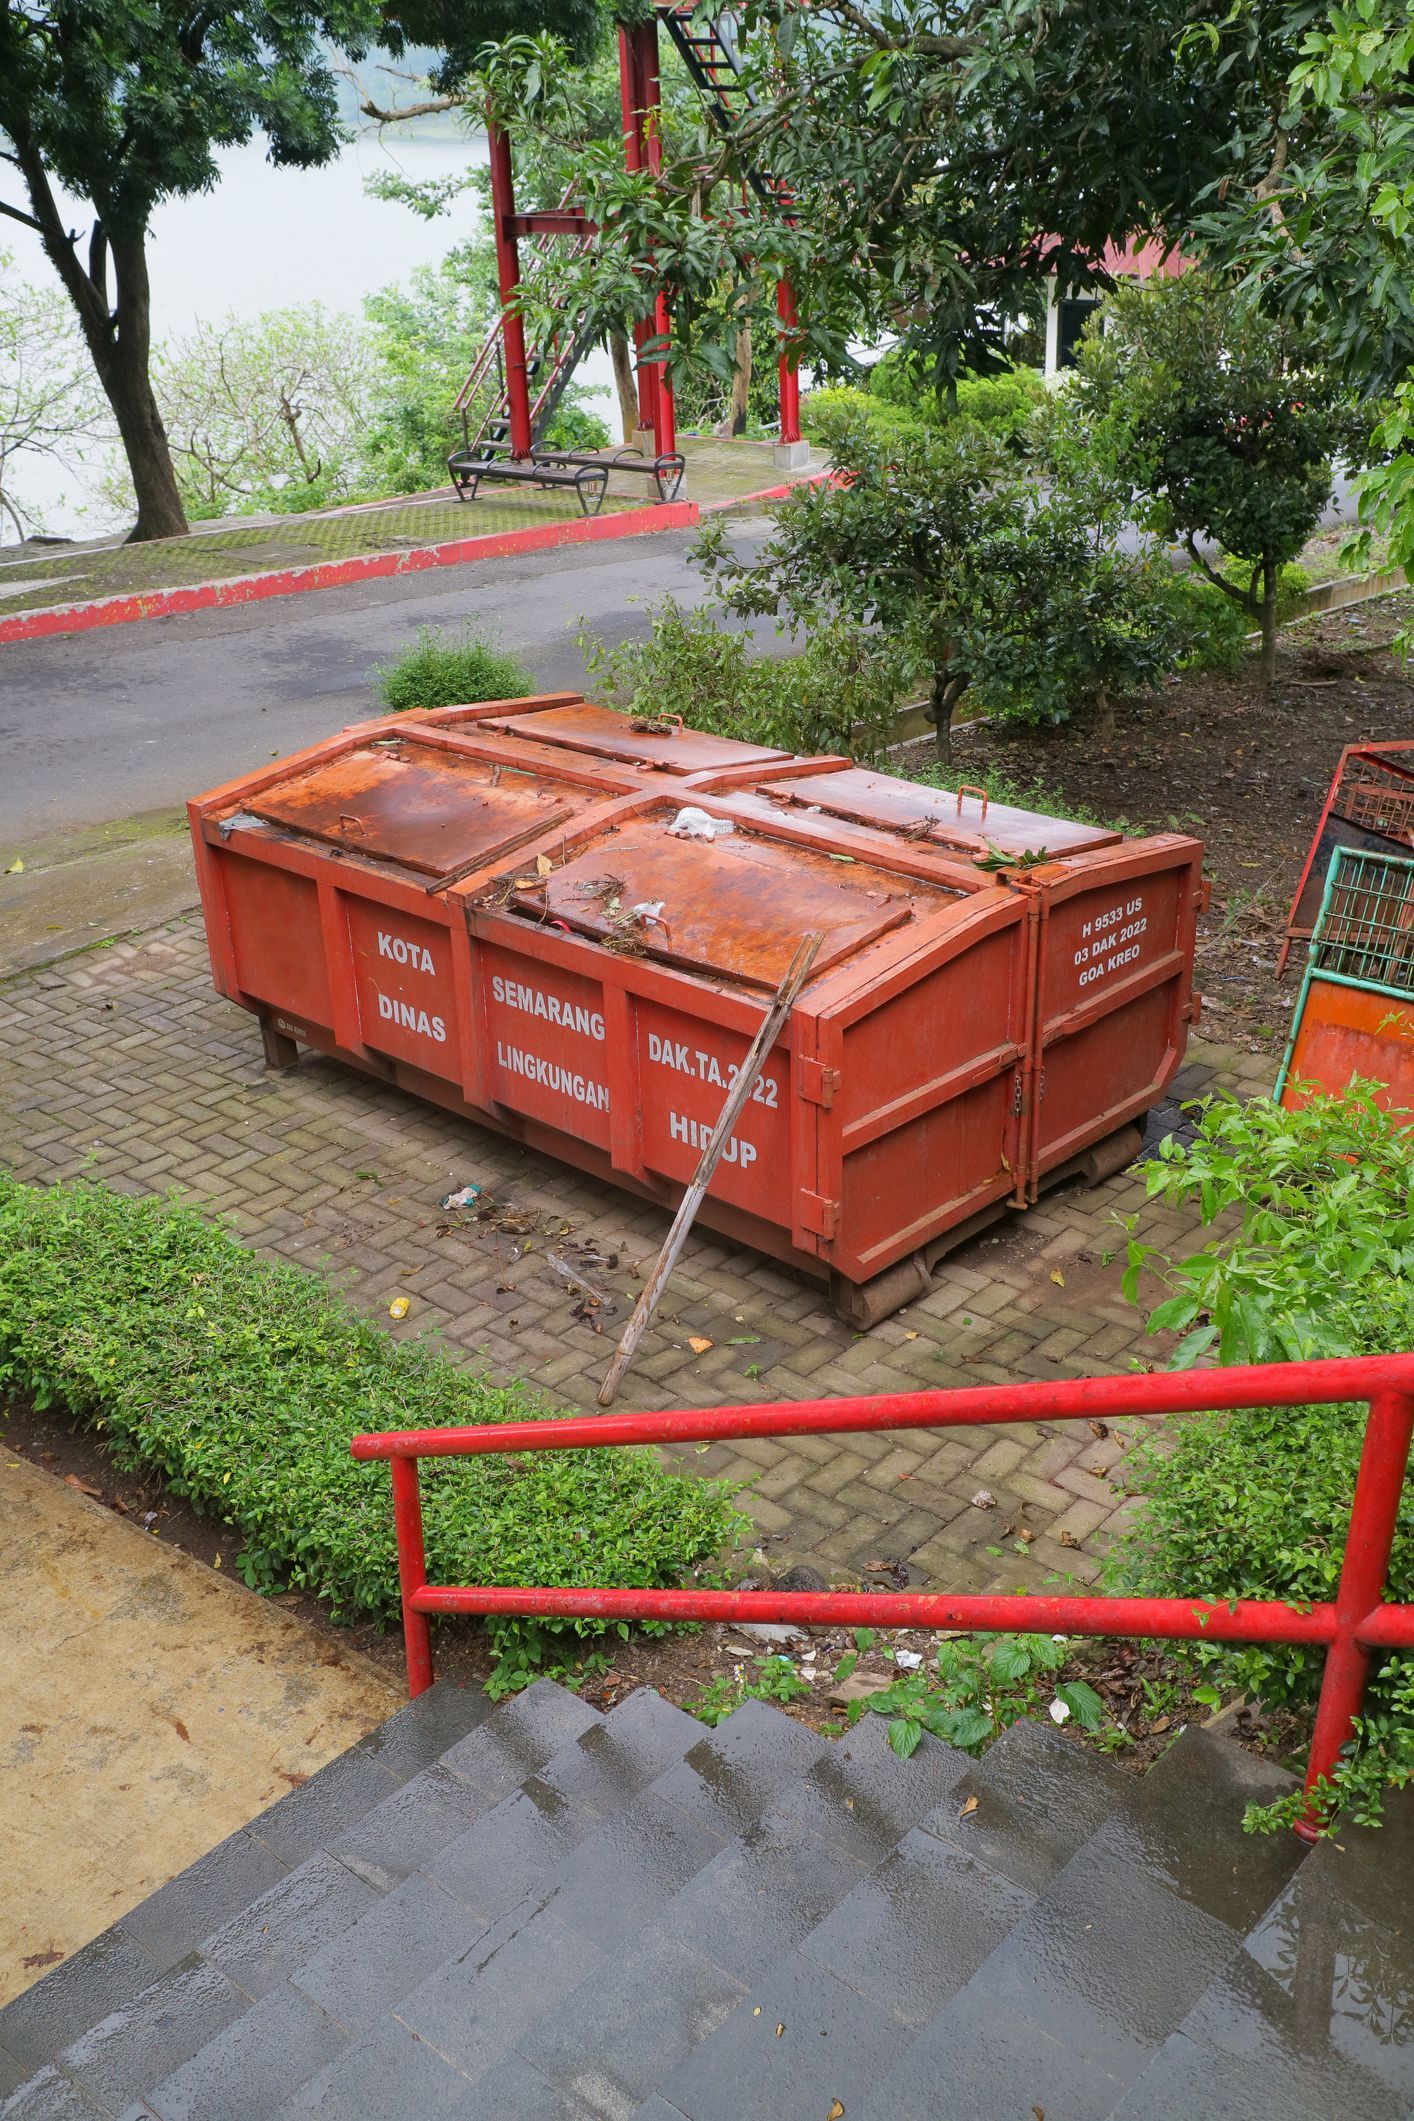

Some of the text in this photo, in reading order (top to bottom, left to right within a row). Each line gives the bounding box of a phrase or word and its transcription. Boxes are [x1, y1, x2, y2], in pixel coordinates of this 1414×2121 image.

[1074, 917, 1147, 966] 03 DAK 2022
[1082, 897, 1143, 938] H 9533 US
[1079, 944, 1140, 986] GOA KREO
[377, 931, 778, 1109] KOTA SEMARANG DAK.TA.222
[378, 993, 447, 1042] DINAS
[497, 1040, 610, 1113] LINGKUNGAN
